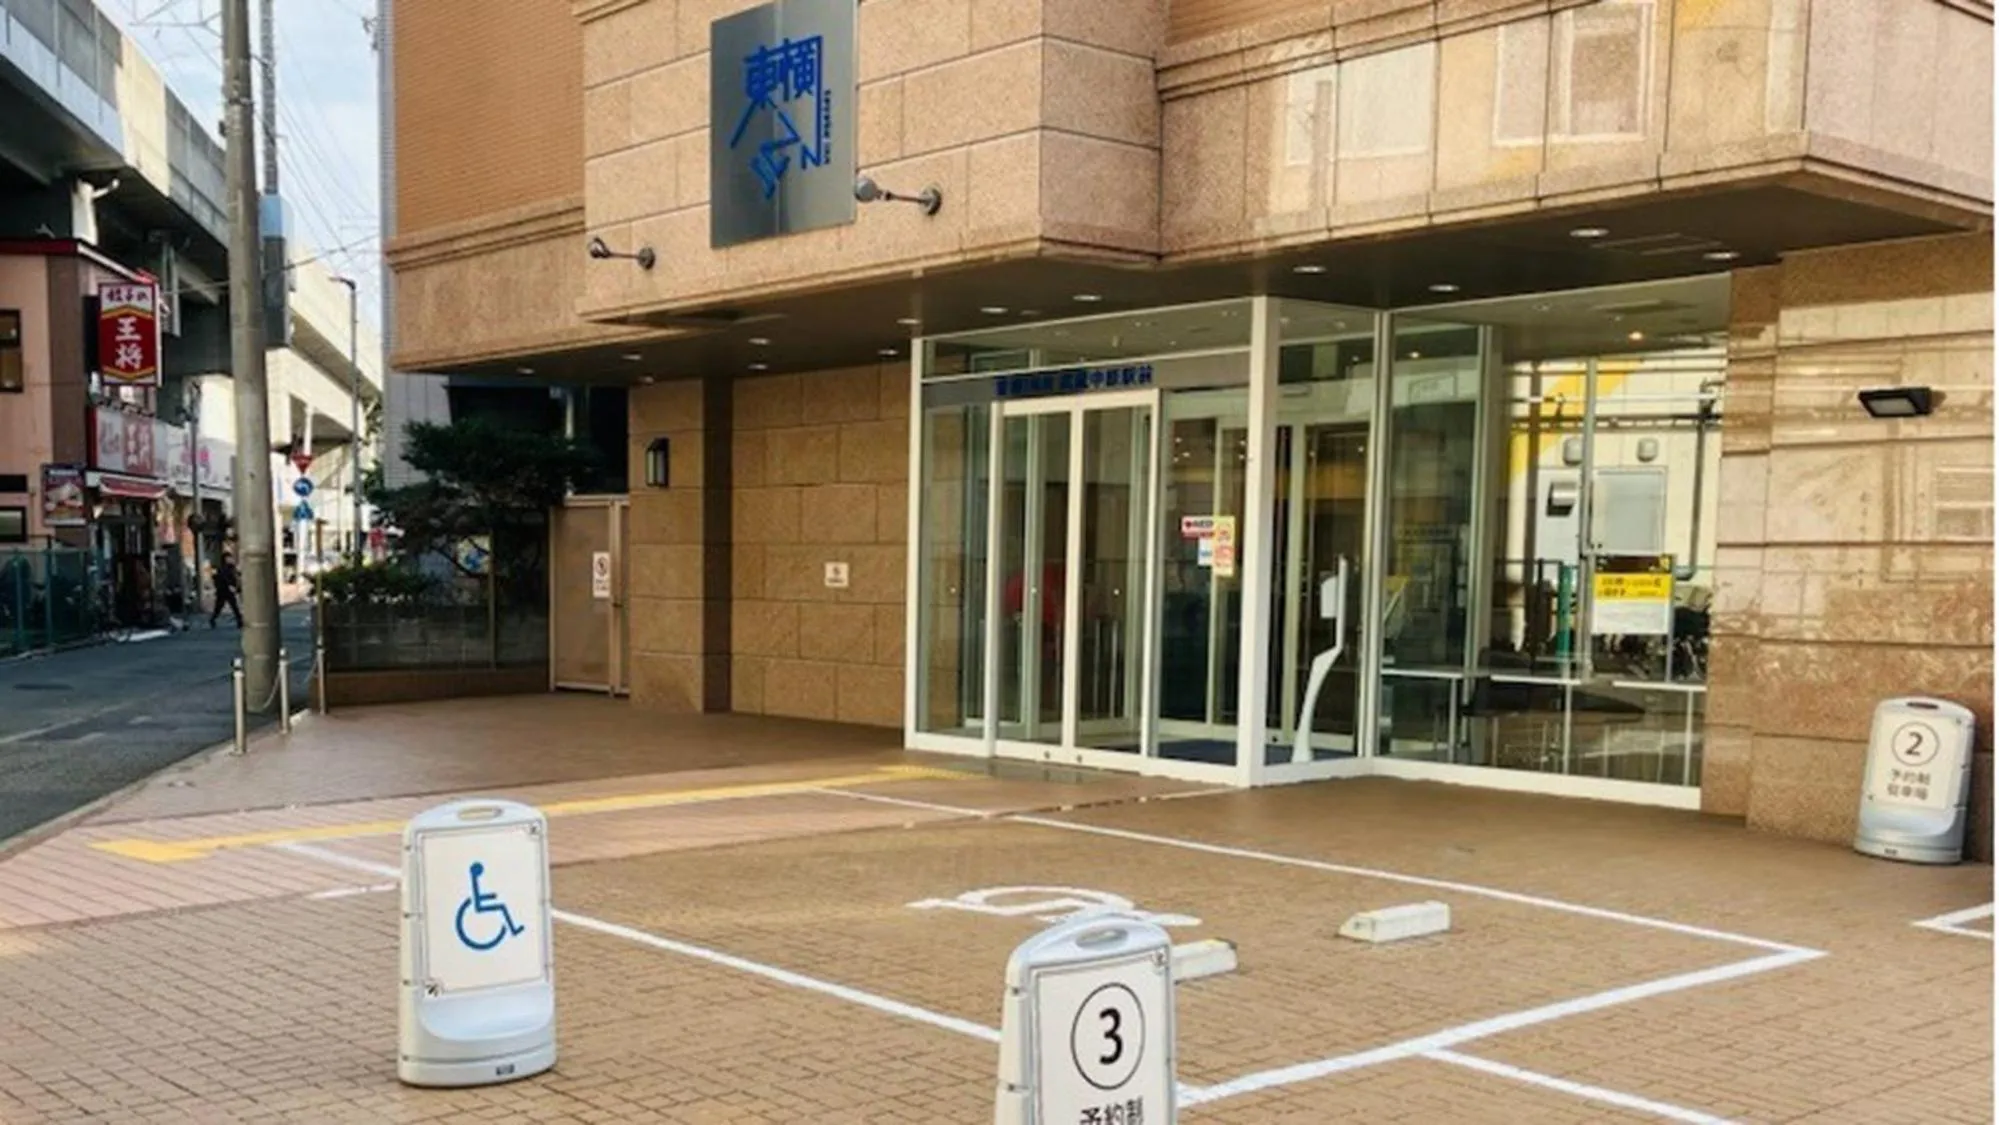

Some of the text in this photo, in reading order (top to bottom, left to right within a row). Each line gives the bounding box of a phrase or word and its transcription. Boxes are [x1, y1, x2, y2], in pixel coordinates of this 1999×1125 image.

[114, 316, 143, 370] 王将
[1905, 732, 1924, 756] 2
[1098, 1007, 1123, 1066] 3
